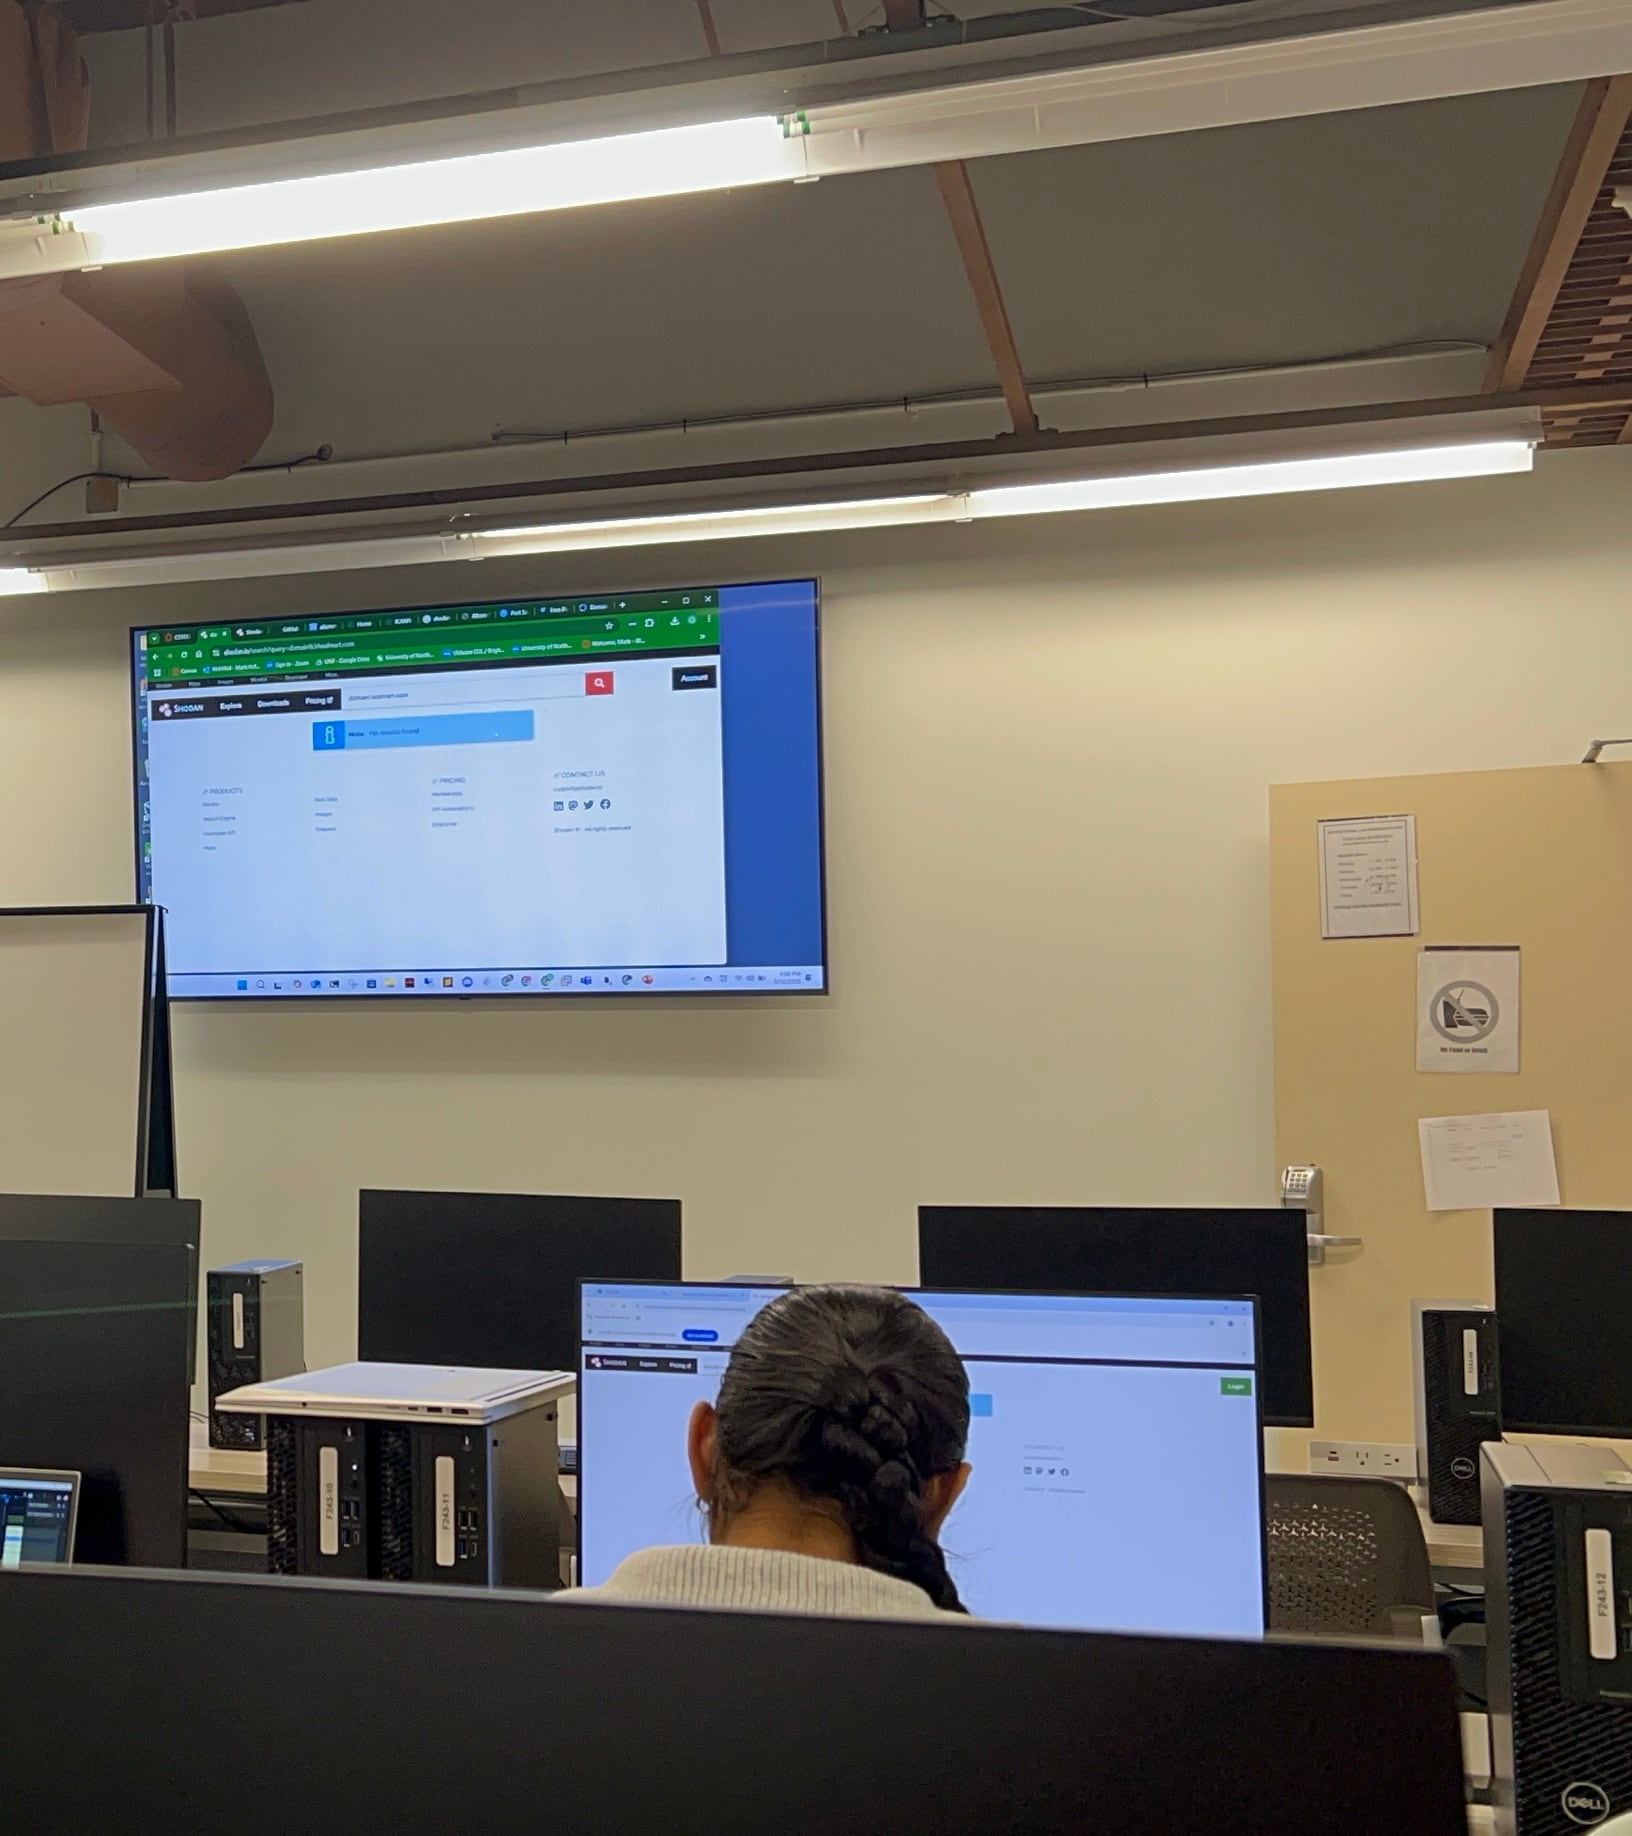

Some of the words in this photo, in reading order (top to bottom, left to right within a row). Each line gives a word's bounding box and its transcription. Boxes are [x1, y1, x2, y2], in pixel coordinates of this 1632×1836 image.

[257, 699, 290, 709] Downloads
[305, 696, 327, 706] Pricing
[219, 702, 243, 711] Explore
[209, 786, 244, 795] PRODUCTS
[442, 1493, 450, 1530] F243-11
[1596, 1572, 1608, 1617] F243-12
